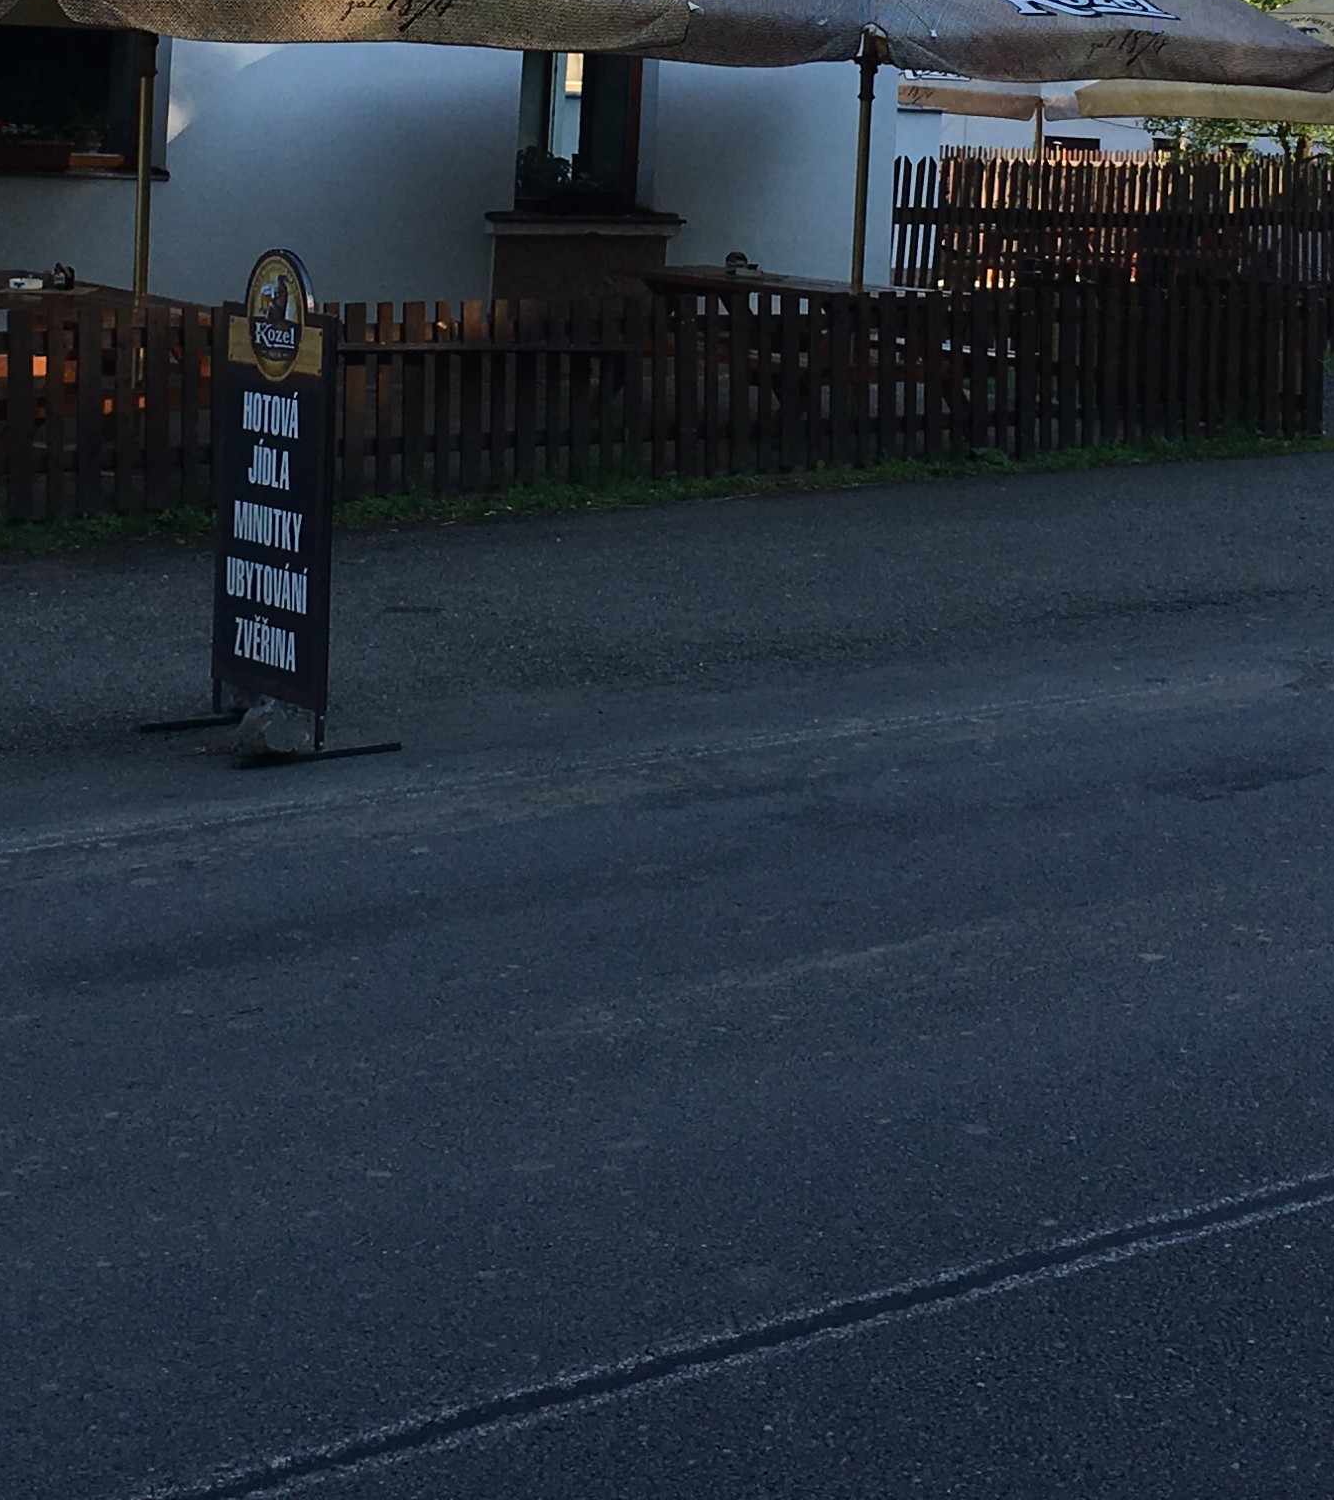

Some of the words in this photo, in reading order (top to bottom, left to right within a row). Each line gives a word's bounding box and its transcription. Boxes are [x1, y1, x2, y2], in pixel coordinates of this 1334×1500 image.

[255, 322, 296, 349] Kozel
[243, 391, 299, 439] HOTOVÁ
[248, 438, 290, 491] JÍDLA
[234, 499, 303, 553] MINUTKY
[227, 555, 308, 615] UBYTOVÁNÍ
[234, 614, 296, 673] ZVĚŘINA
